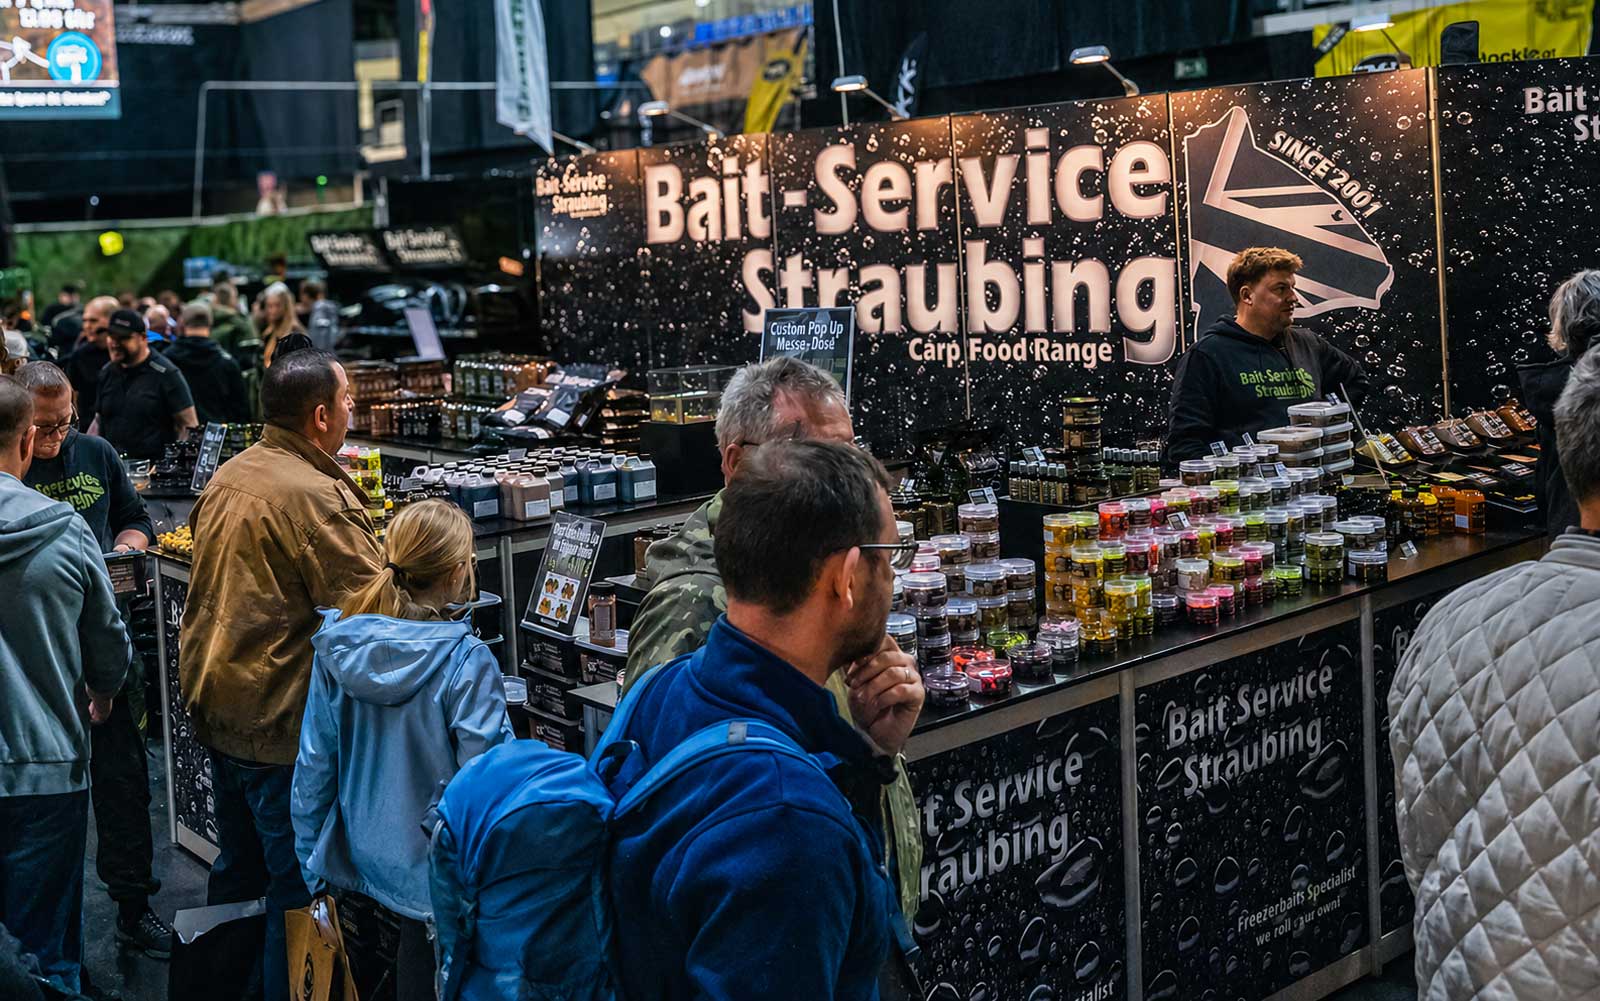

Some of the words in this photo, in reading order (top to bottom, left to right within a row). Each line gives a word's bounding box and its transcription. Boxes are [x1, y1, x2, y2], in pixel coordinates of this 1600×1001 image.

[644, 127, 1171, 244] Bait-Service
[1267, 130, 1336, 180] SINCE
[1327, 168, 1383, 219] 2001
[742, 237, 1177, 365] Straubing
[770, 321, 806, 336] Custom
[808, 320, 828, 339] Pop
[829, 320, 844, 339] Up
[776, 336, 836, 351] Messe-Dose
[908, 337, 961, 368] Carp
[969, 338, 1027, 362] Food
[1033, 338, 1113, 369] Range
[1168, 695, 1229, 750] Bait
[1236, 665, 1333, 726] Service
[953, 751, 1083, 829] Service
[1183, 717, 1322, 797] Straubing
[920, 813, 1069, 902] raubing
[1238, 891, 1305, 933] Freezerbaits
[1307, 865, 1356, 901] Specialist
[1255, 931, 1271, 947] we
[1274, 916, 1291, 938] roll
[1317, 895, 1341, 917] own!
